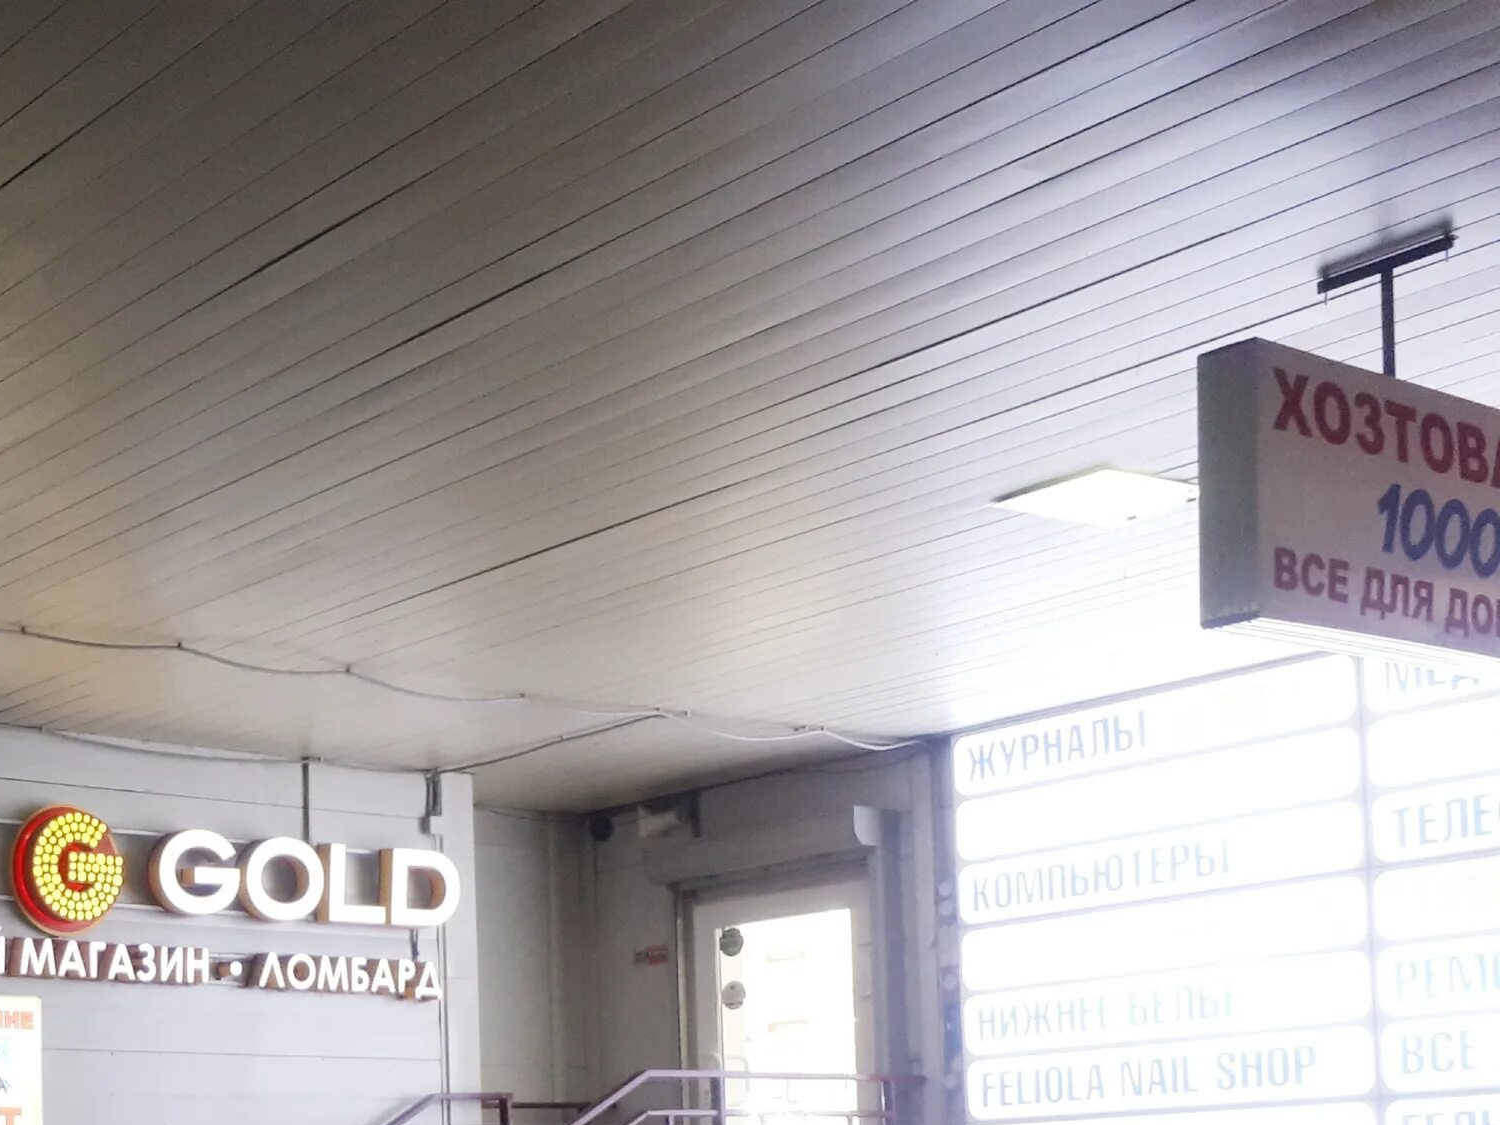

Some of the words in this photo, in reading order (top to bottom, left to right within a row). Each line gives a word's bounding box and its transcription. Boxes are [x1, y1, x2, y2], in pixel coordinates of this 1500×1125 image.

[1272, 366, 1500, 487] ХОЗТОВ
[1273, 546, 1350, 604] ВСЕ
[1360, 566, 1435, 624] ДЛЯ
[1445, 587, 1500, 640] ДО
[968, 709, 1147, 782] ЖУРНАЛЫ
[1393, 792, 1500, 857] ТЕЛЕ
[156, 828, 461, 928] GOLD
[972, 838, 1232, 913] КОМПЬЮТЕРЫ
[16, 936, 211, 986] МАГАЗИН
[255, 950, 443, 1002] ЛОМБАРД
[982, 1060, 1105, 1108] FELIOLA
[1120, 1055, 1199, 1098] NAIL
[1215, 1044, 1318, 1092] SHOP
